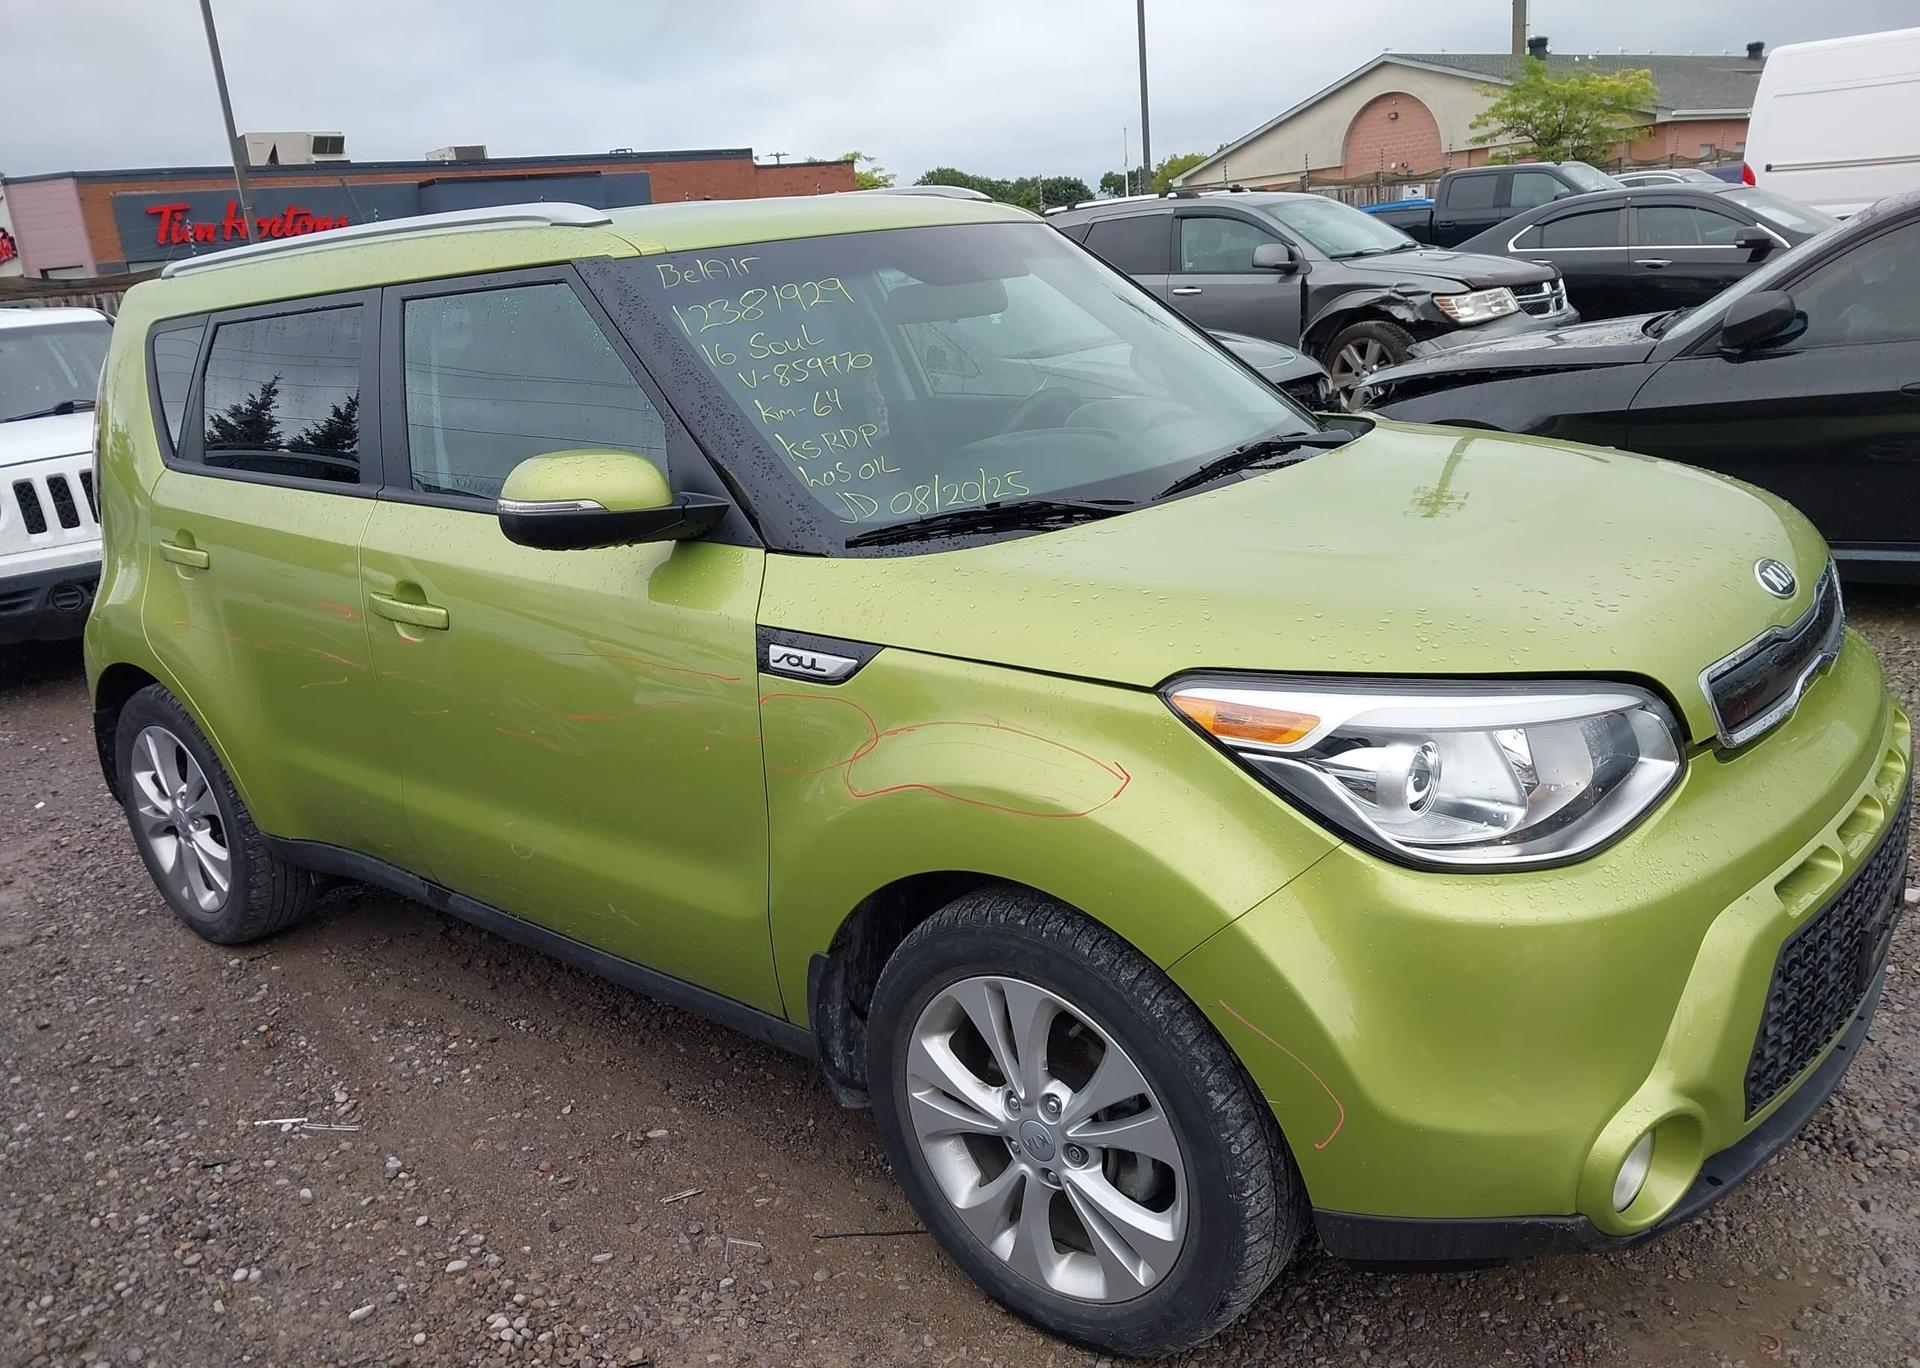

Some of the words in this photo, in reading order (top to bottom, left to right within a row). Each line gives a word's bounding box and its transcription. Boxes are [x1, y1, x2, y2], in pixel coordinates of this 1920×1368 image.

[145, 202, 216, 246] Tim
[672, 277, 855, 336] 12381929
[701, 343, 737, 368] 16
[835, 492, 878, 524] JD
[889, 468, 1031, 515] 08/20/25
[772, 653, 827, 673] SOUL
